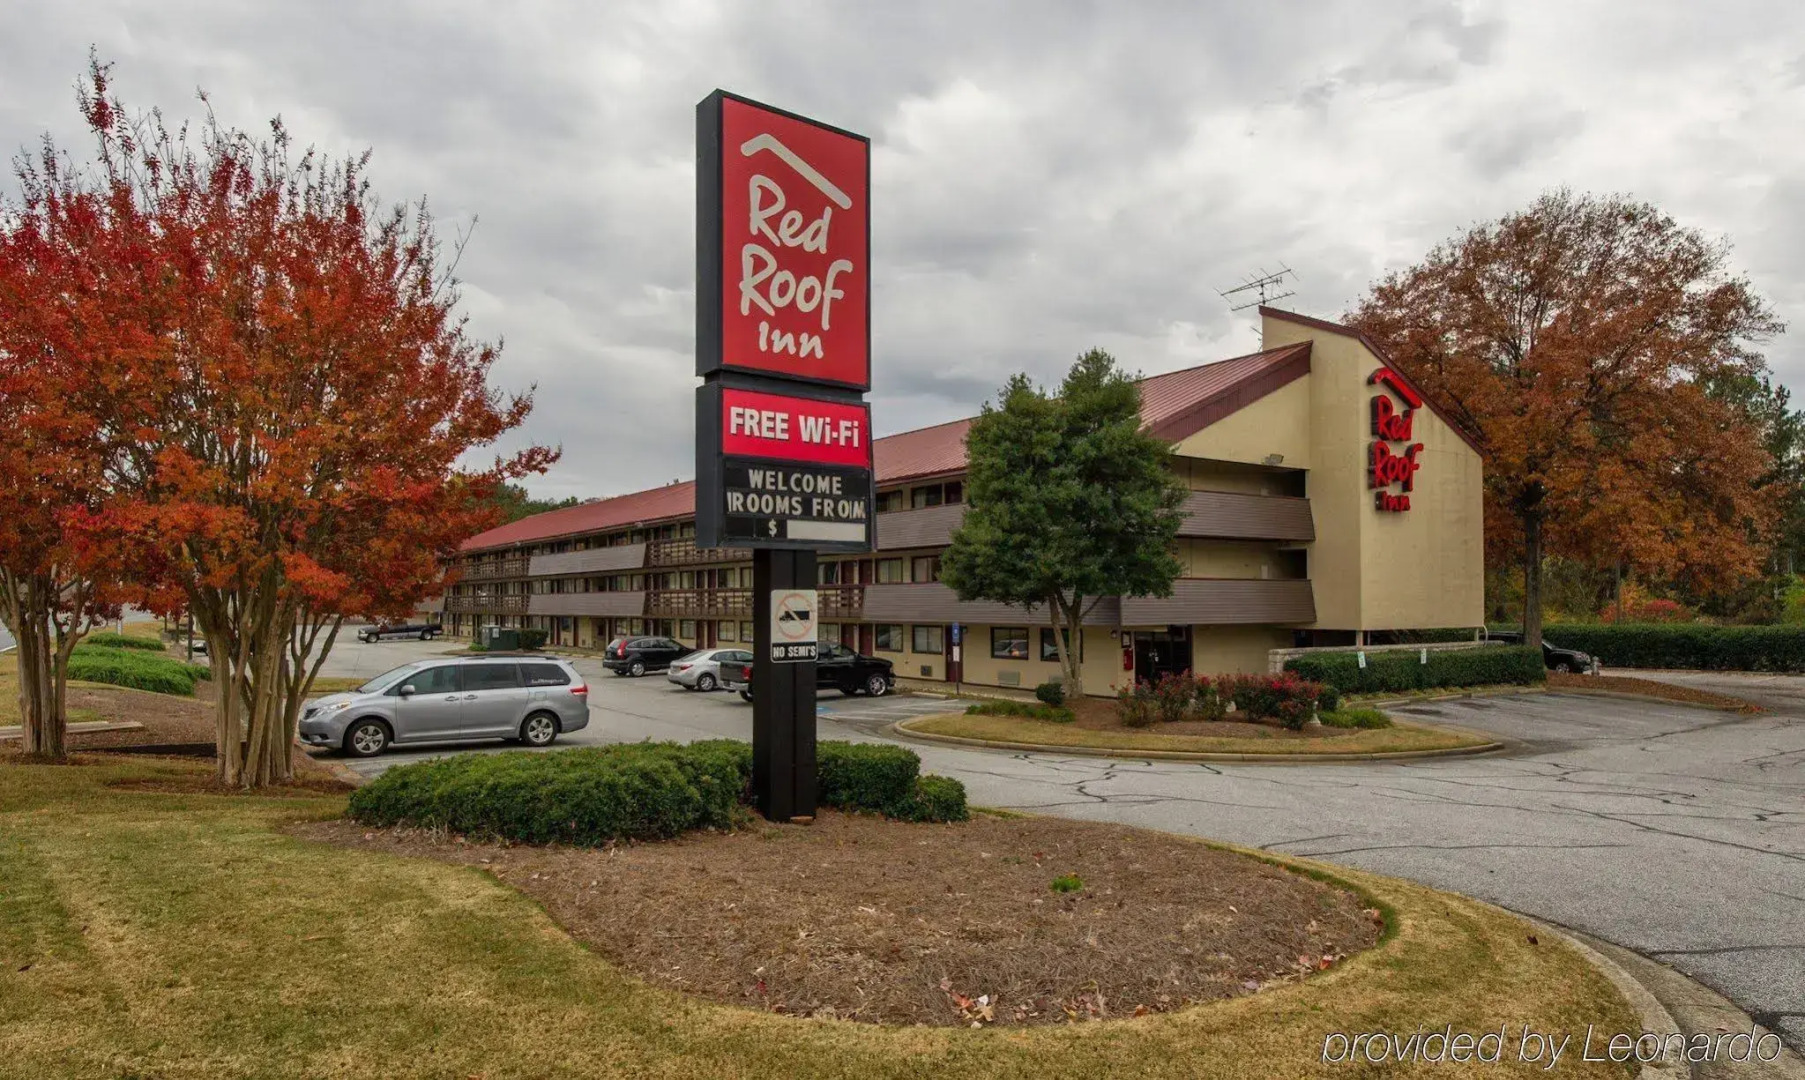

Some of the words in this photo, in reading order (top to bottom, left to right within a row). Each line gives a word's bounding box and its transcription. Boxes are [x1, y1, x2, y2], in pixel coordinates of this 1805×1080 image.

[749, 174, 832, 254] Red
[739, 243, 853, 331] Roof
[759, 321, 824, 359] Inn
[730, 406, 789, 440] FREE
[798, 414, 859, 447] Wi-Fi
[1370, 395, 1414, 441] Red
[748, 469, 842, 495] WELCOME
[1367, 440, 1424, 492] Roof
[731, 492, 802, 515] ROOMS
[812, 498, 866, 519] FROM
[1375, 491, 1410, 511] Inn
[773, 646, 785, 658] NO
[788, 645, 816, 657] SEMI'S
